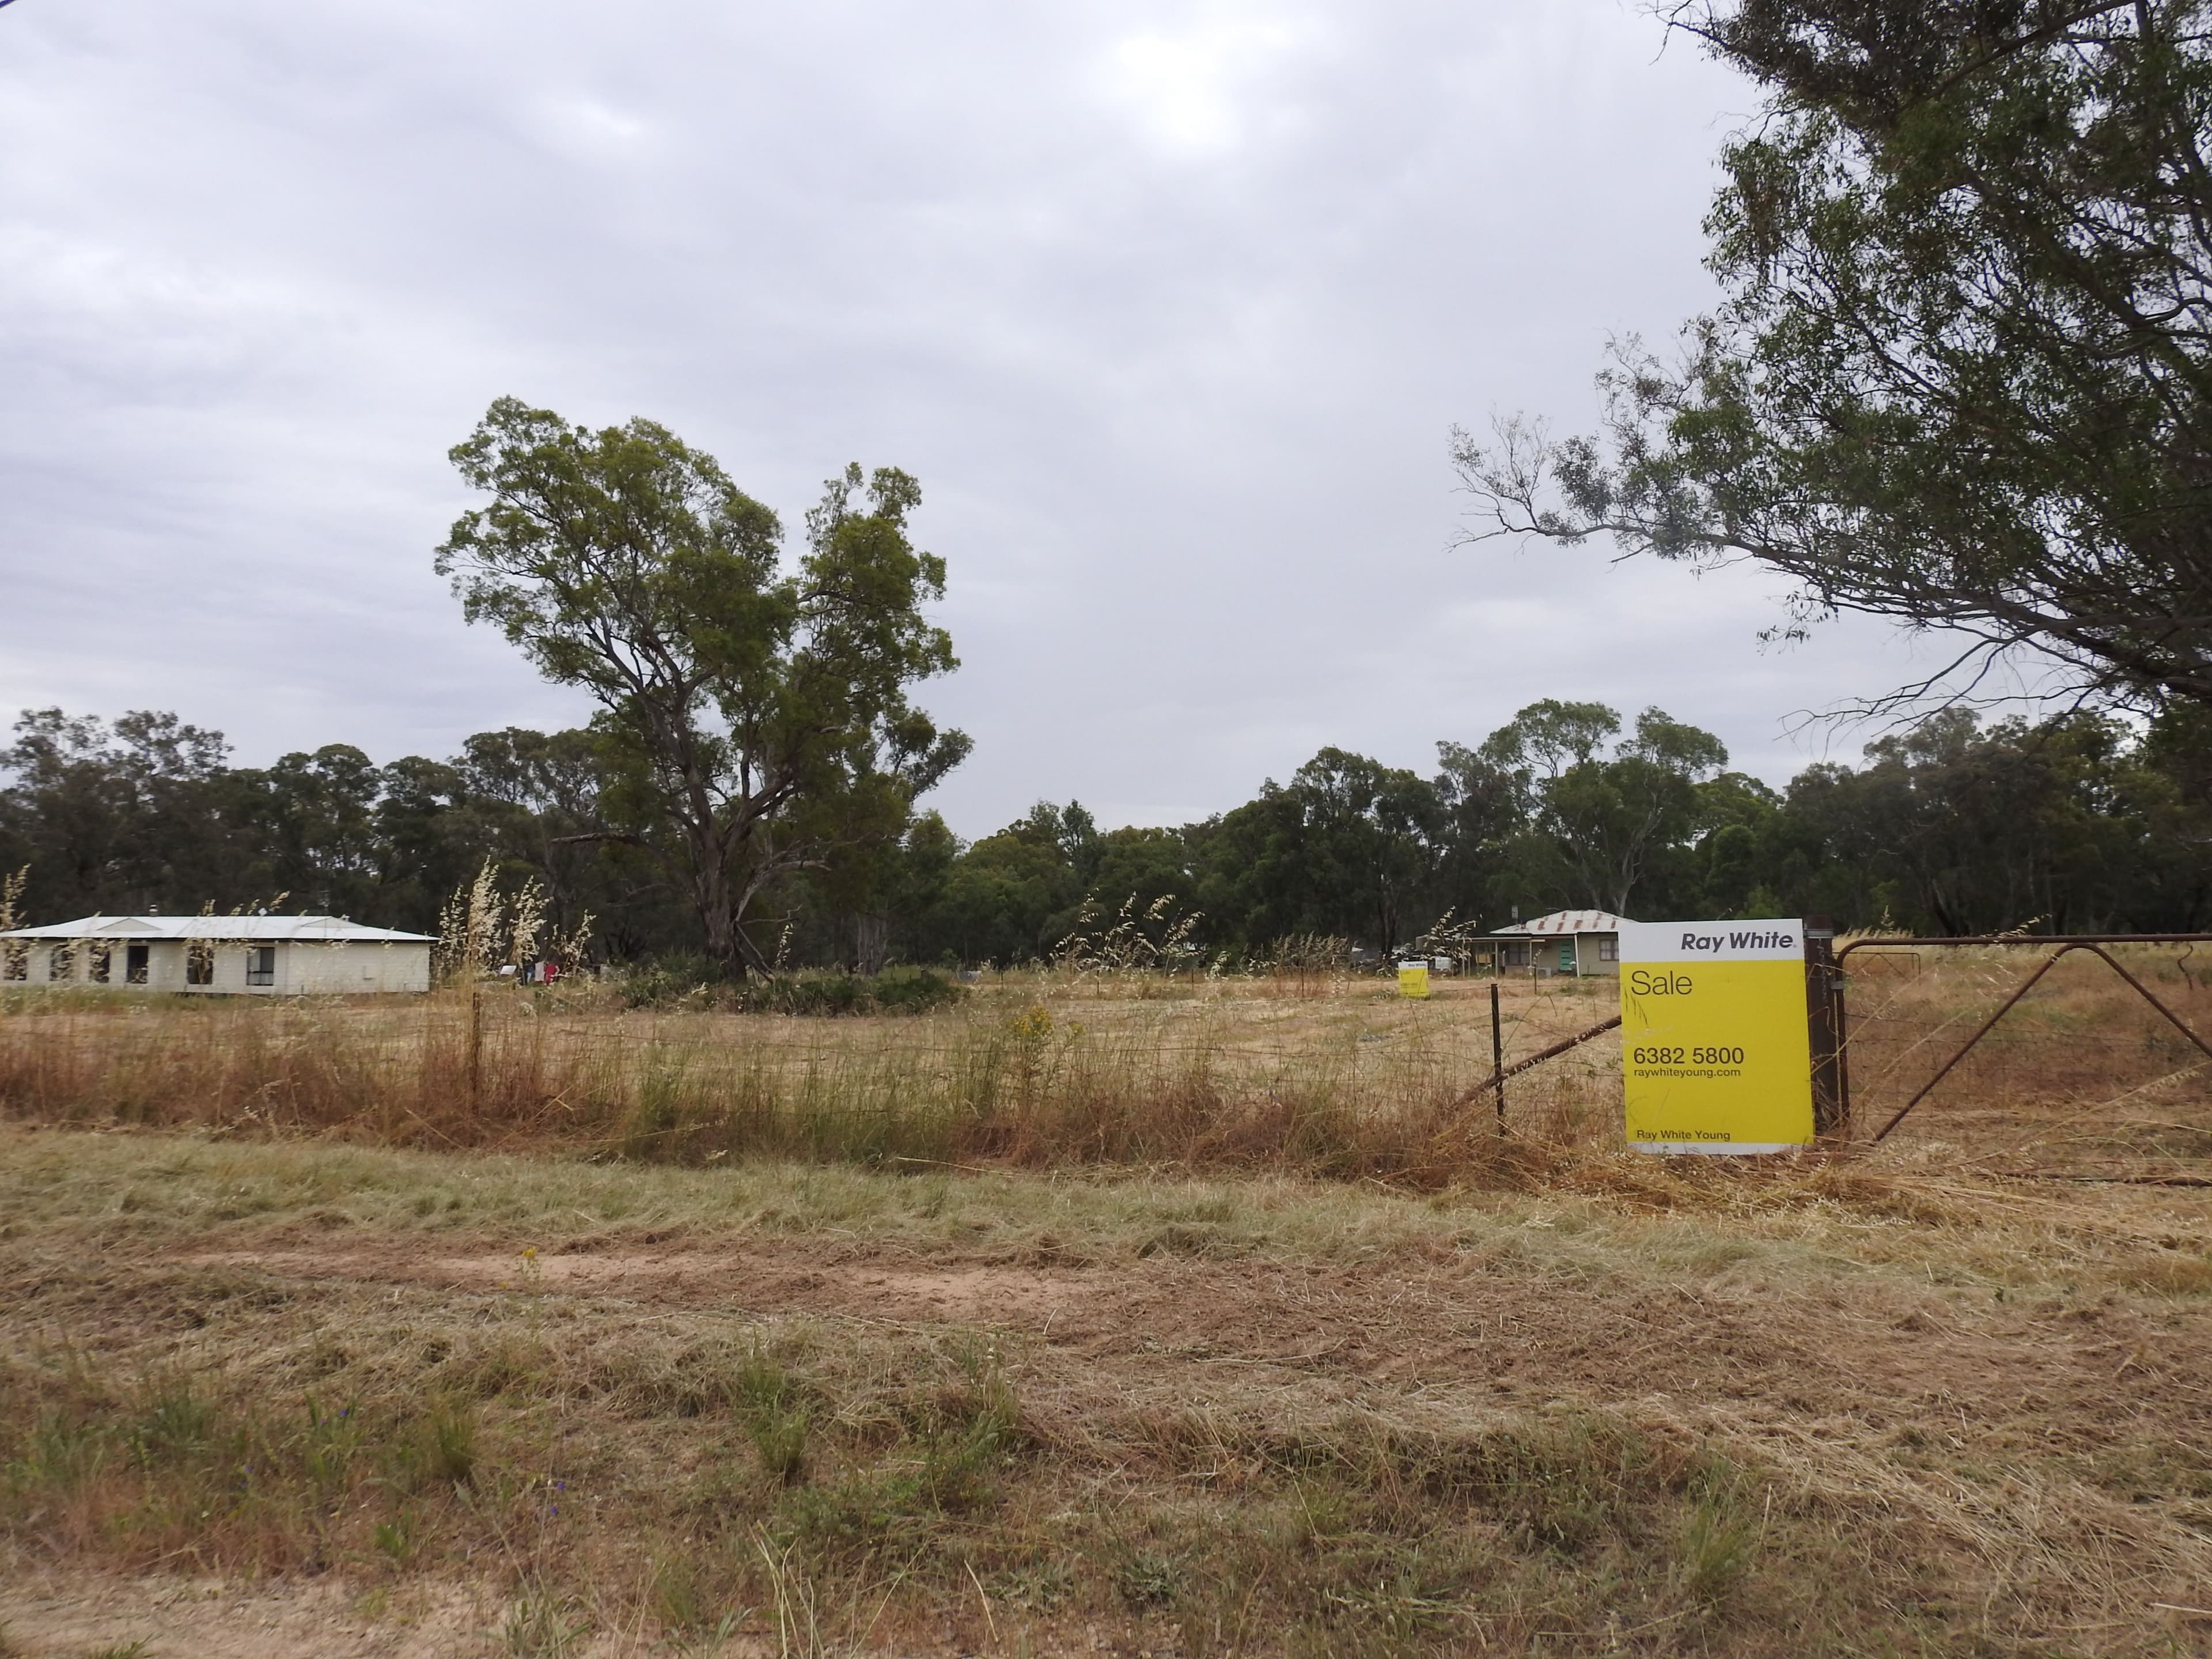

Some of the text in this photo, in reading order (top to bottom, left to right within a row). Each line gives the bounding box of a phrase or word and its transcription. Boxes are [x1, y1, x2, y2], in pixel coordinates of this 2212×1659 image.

[1681, 931, 1793, 953] Ray White
[1631, 970, 1692, 995] Sale
[1633, 1047, 1745, 1065] 6382 5800
[1634, 1067, 1741, 1078] raywhiteyoung.com
[1637, 1130, 1730, 1142] Ray White Young
